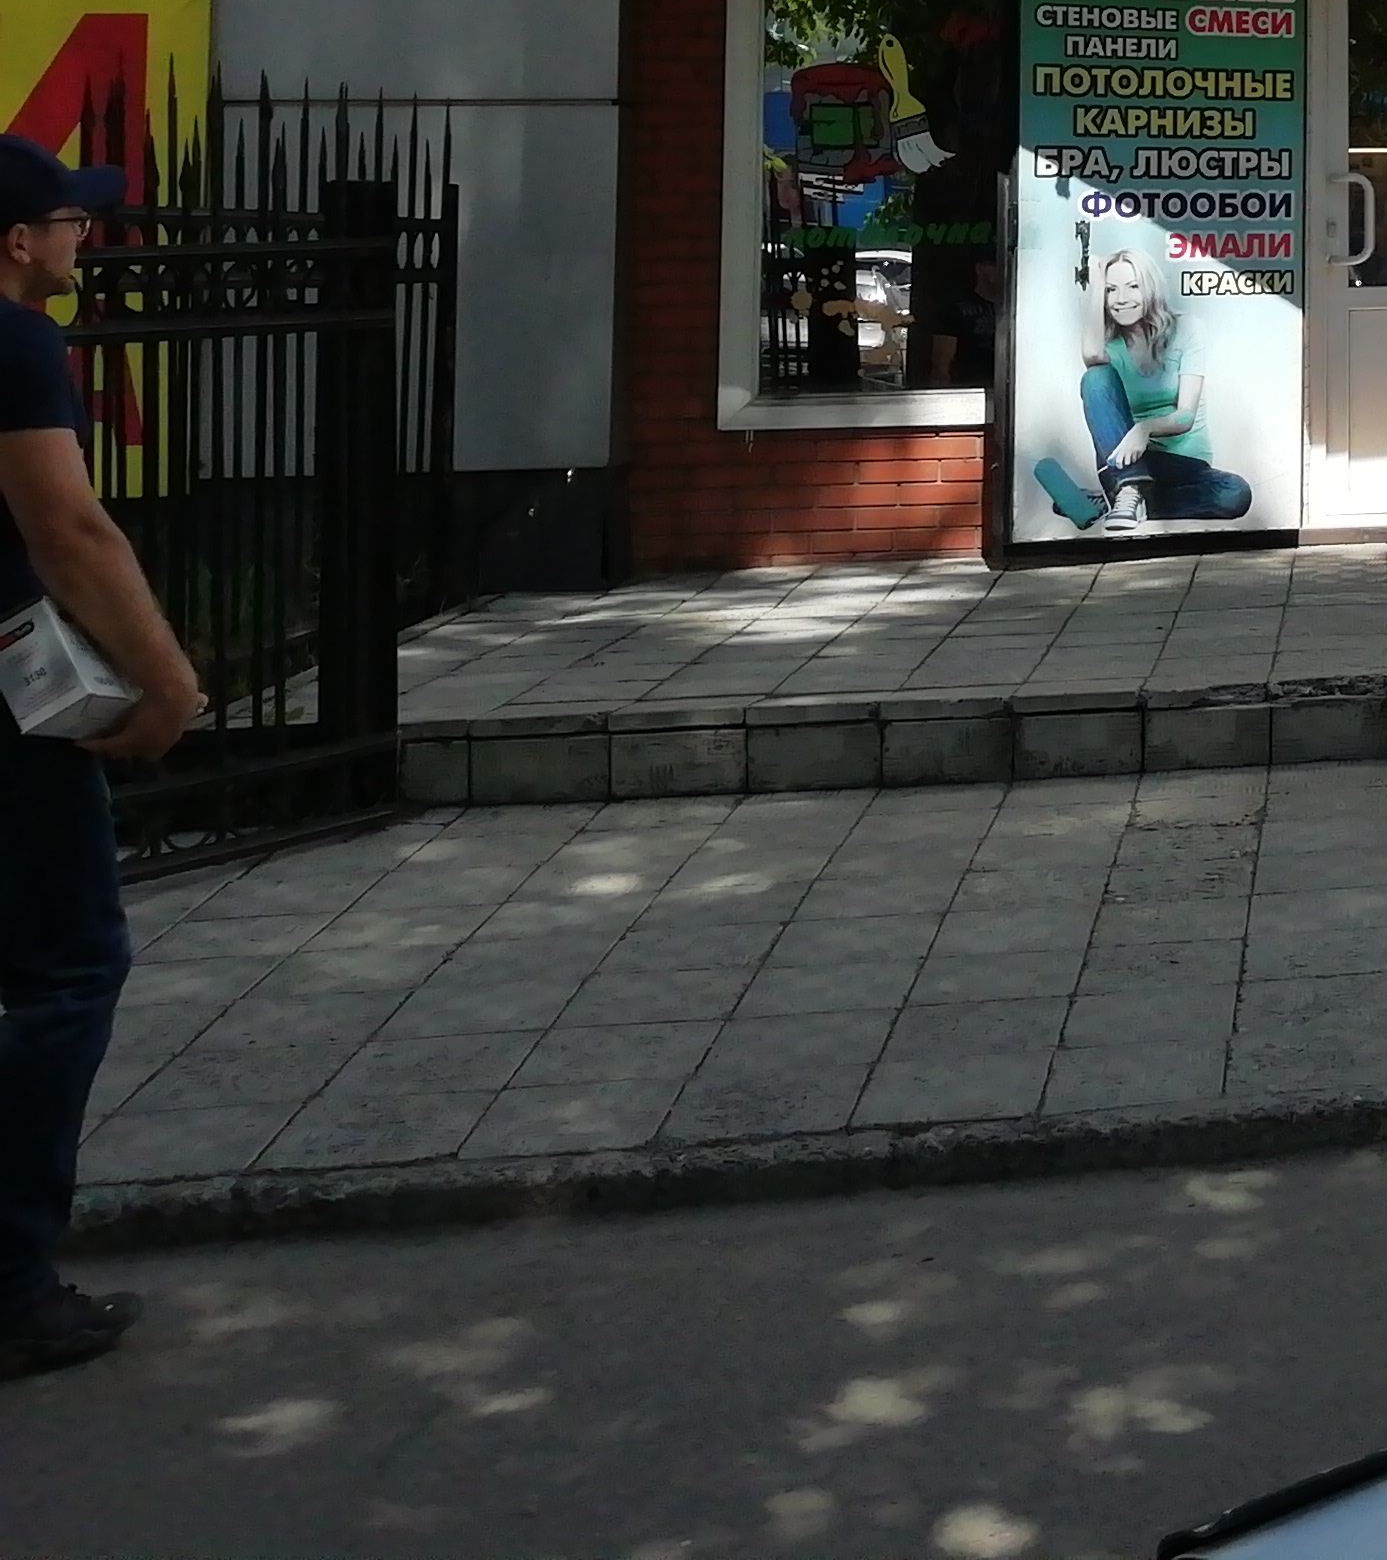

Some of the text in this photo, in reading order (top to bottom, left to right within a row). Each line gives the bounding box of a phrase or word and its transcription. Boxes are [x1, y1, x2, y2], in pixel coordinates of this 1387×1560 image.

[1036, 5, 1177, 30] СТЕНОВЫЕ
[1187, 7, 1294, 37] СМЕСИ
[1066, 36, 1177, 59] ПАНЕЛИ
[1035, 65, 1293, 100] ПОТОЛОЧНЫЕ
[1074, 107, 1255, 138] КАРНИЗЫ
[1036, 146, 1291, 182] БРА, ЛЮСТРЫ
[1081, 191, 1292, 219] ФОТООБОИ
[1168, 233, 1292, 258] ЭМАЛИ
[1183, 272, 1293, 295] КРАСКИ
